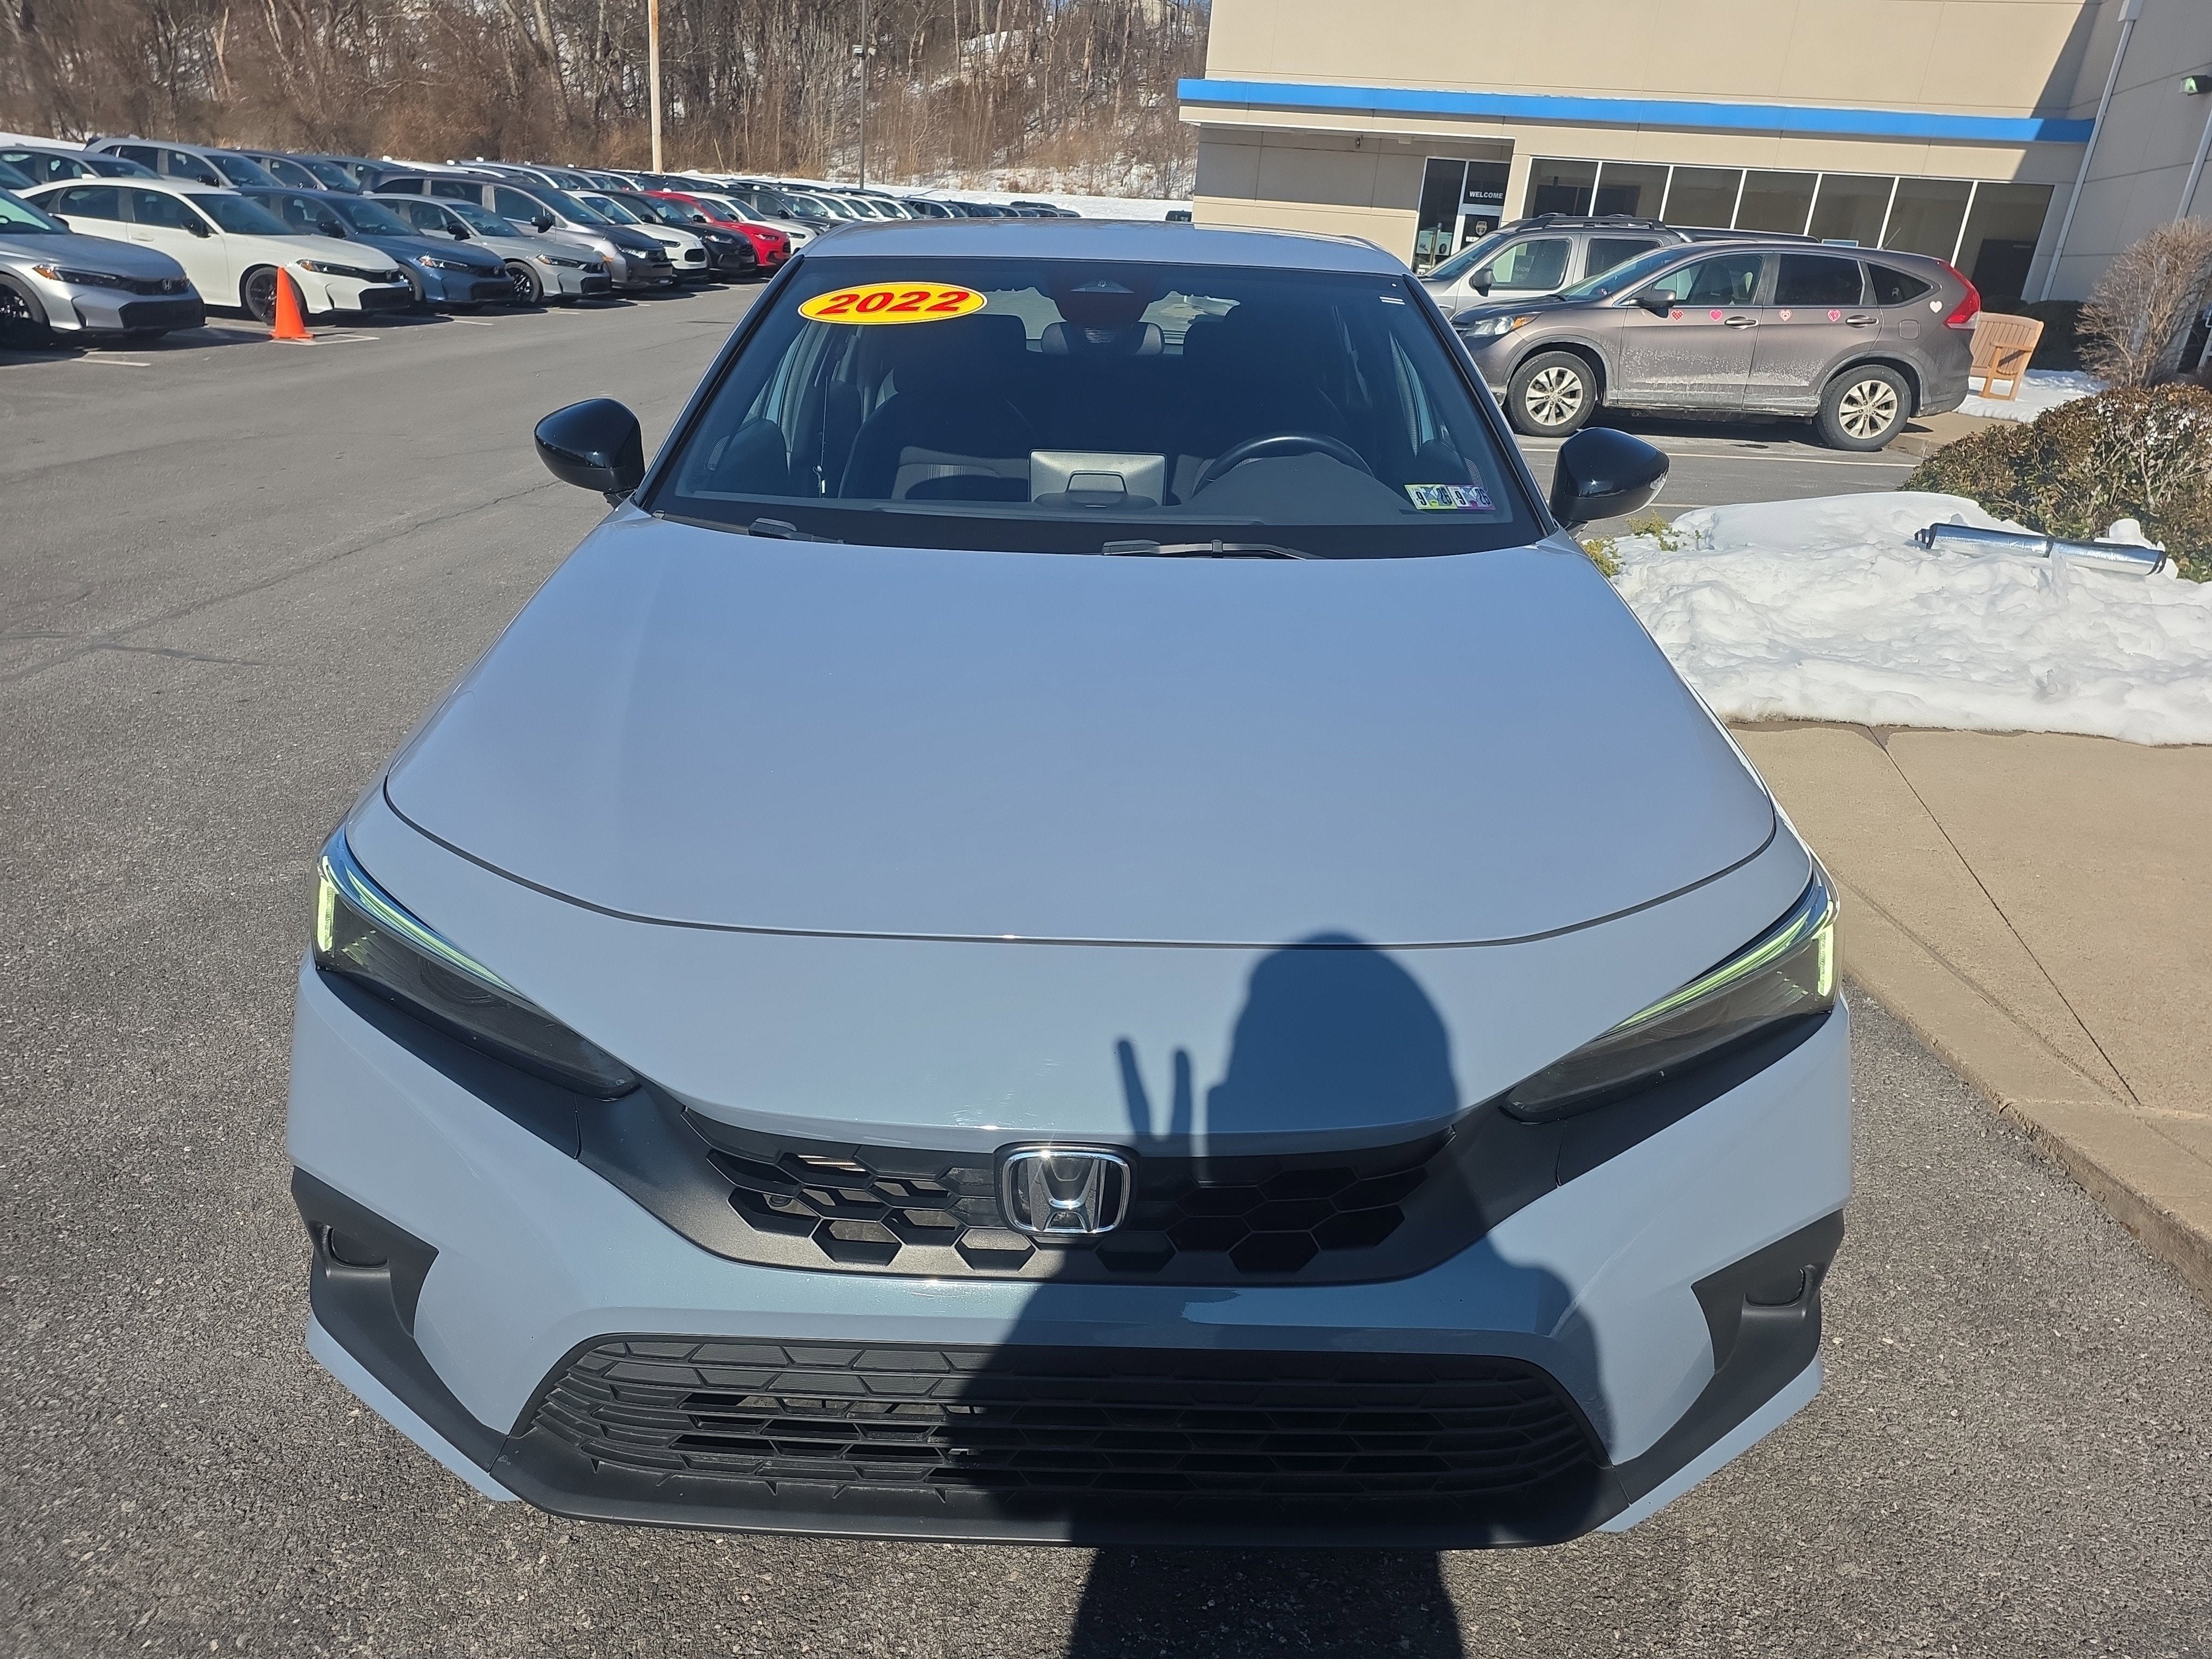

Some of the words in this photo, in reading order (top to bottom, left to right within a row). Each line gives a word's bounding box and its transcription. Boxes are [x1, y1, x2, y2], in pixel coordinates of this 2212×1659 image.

[1469, 191, 1503, 199] WELCOME
[814, 291, 970, 316] 2022
[1416, 491, 1427, 505] 9
[1436, 488, 1452, 505] 26
[1455, 491, 1466, 505] 9
[1475, 488, 1490, 505] 26
